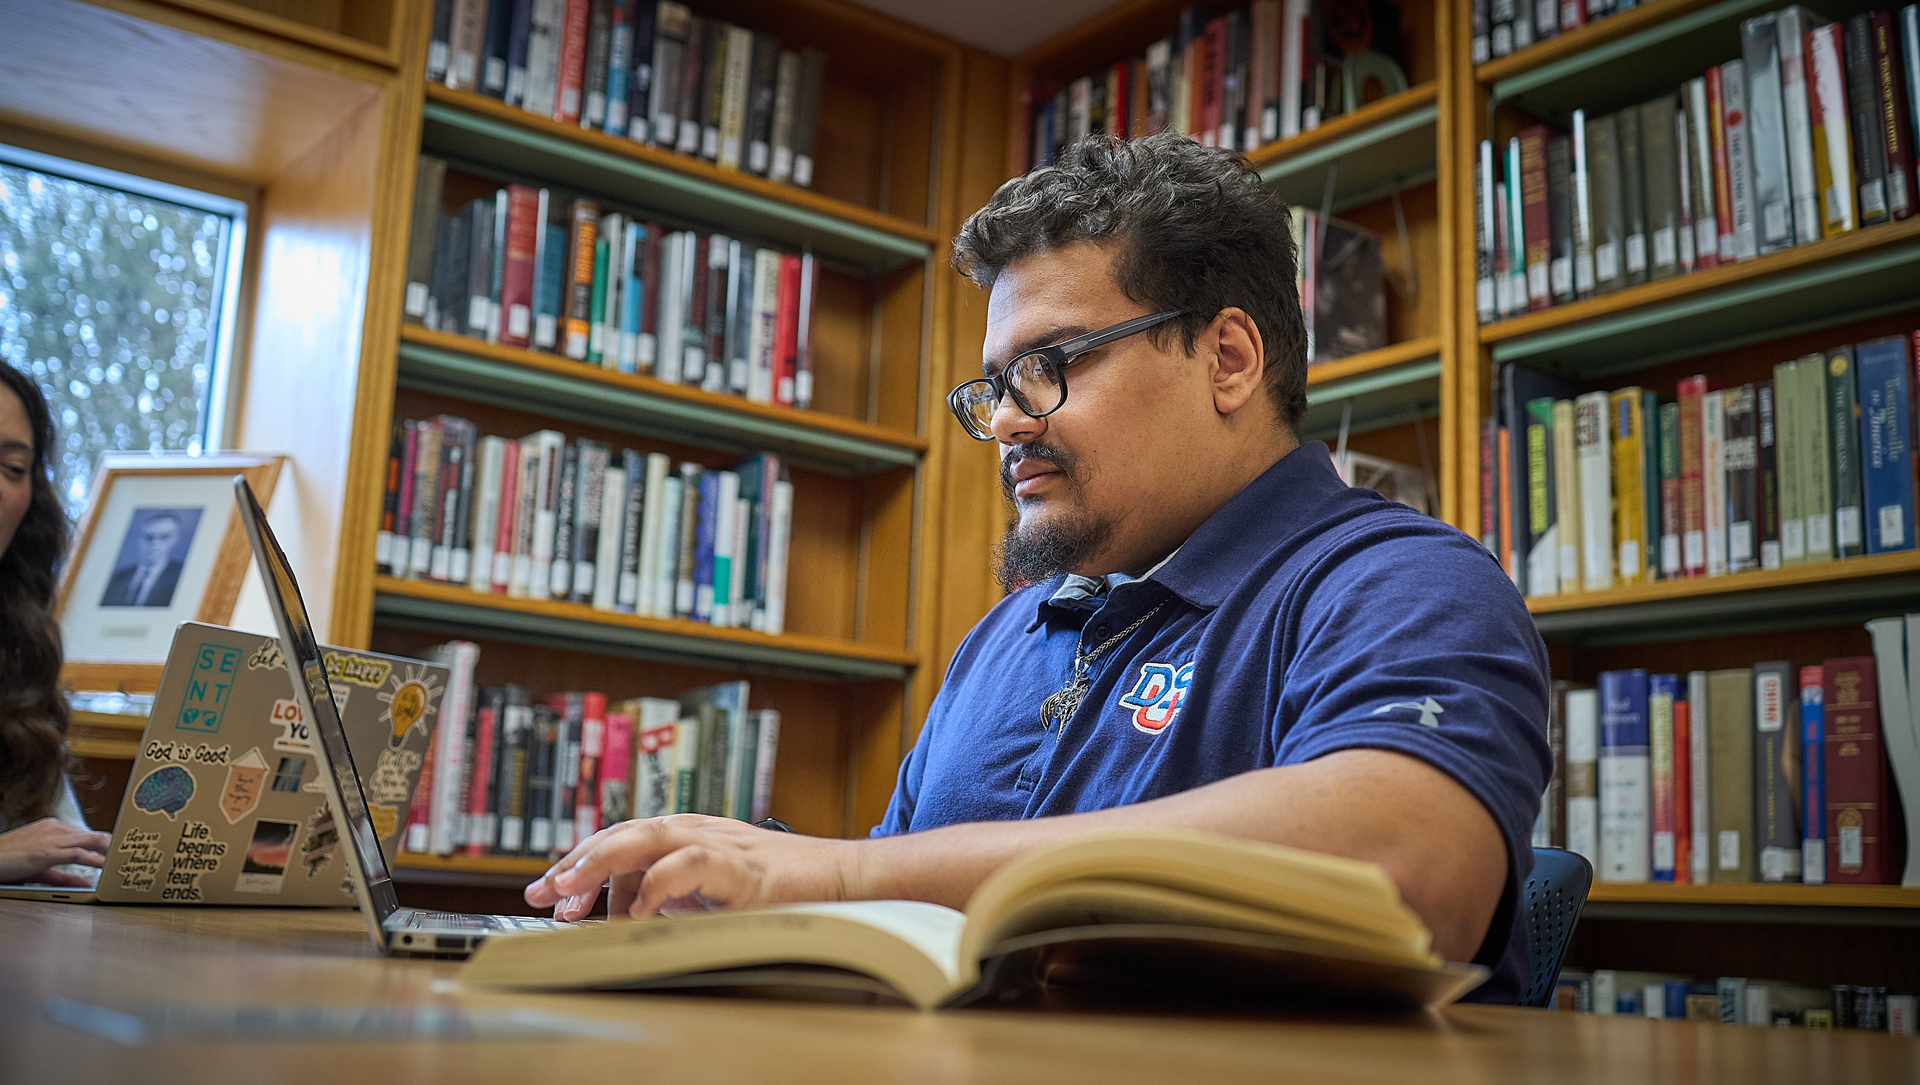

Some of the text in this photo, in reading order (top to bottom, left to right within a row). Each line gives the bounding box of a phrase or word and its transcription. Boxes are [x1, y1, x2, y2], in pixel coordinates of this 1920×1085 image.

[249, 638, 279, 668] Let
[345, 658, 388, 684] happy
[273, 703, 303, 721] LOV
[291, 723, 309, 739] YO
[146, 742, 174, 760] God
[178, 744, 191, 760] is
[181, 822, 208, 839] Life
[176, 839, 226, 857] begins
[172, 854, 218, 871] where
[166, 870, 197, 885] fear
[162, 885, 202, 900] ends.
